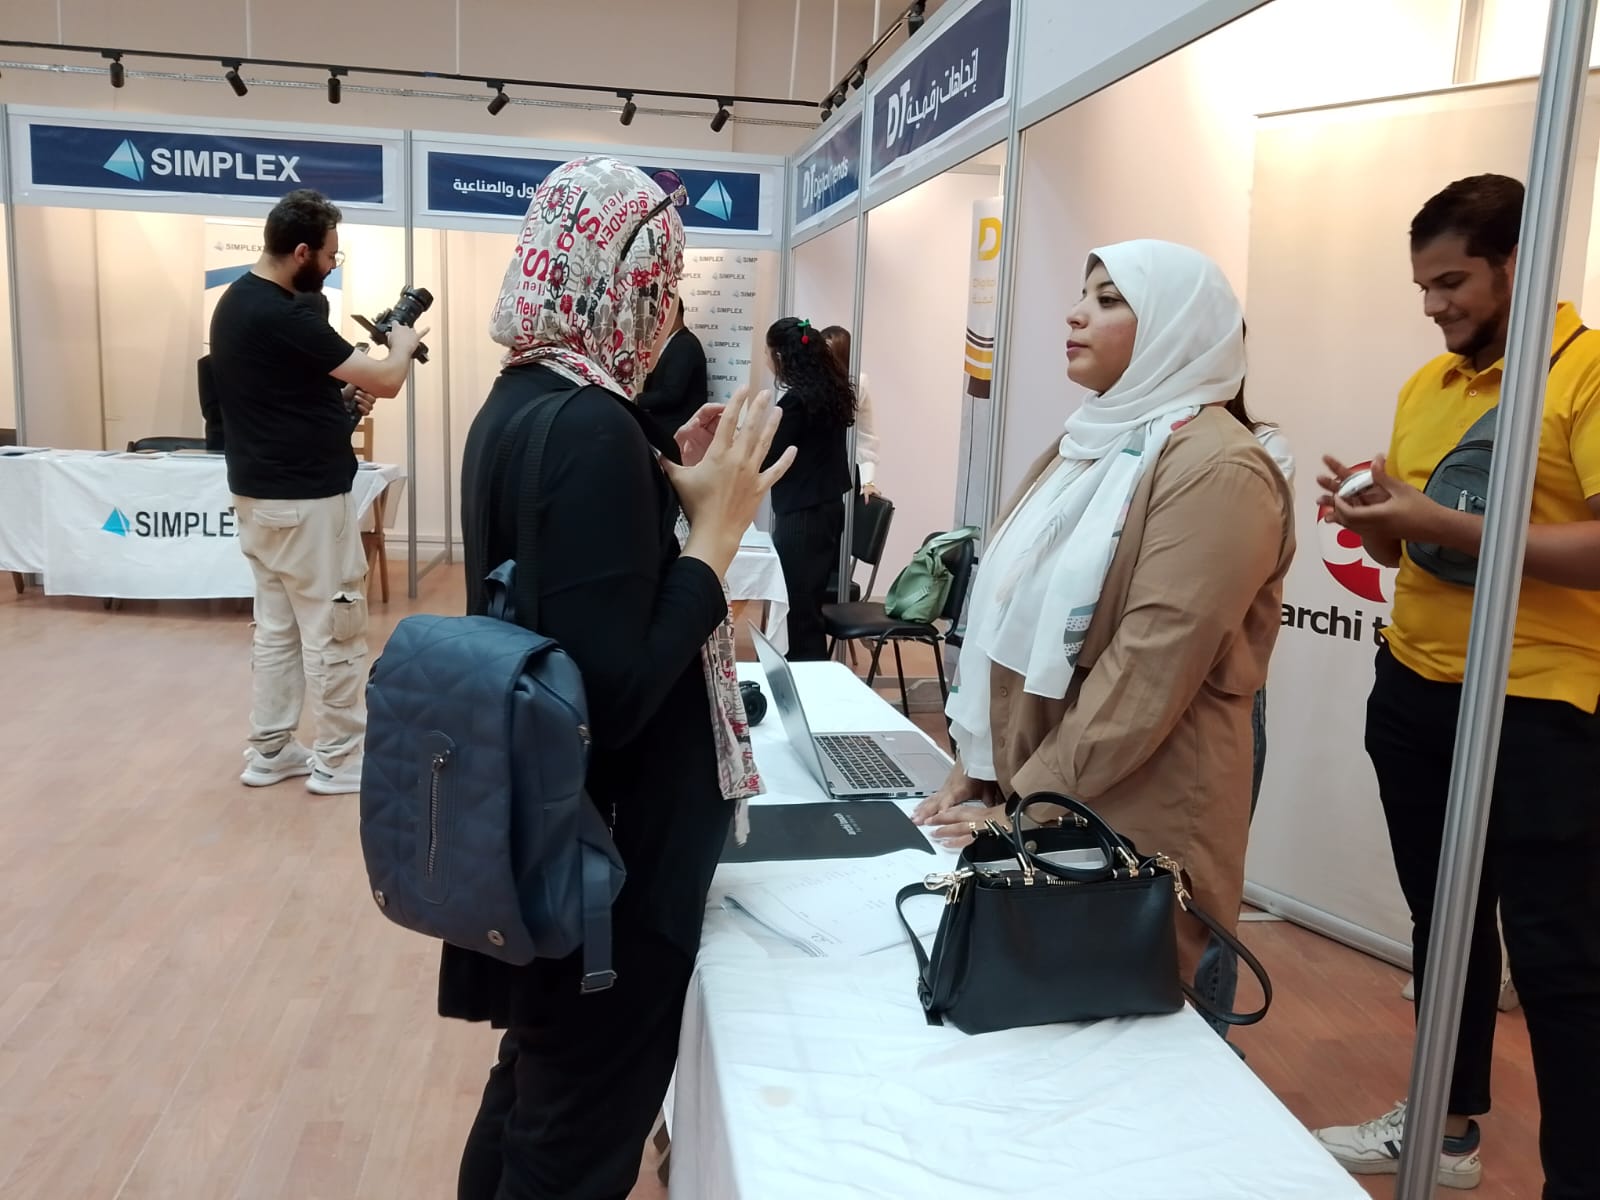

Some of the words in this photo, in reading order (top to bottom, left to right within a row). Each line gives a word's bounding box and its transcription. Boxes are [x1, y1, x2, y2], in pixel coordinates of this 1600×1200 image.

[150, 147, 302, 183] SIMPLEX
[453, 178, 514, 198] والصناعية
[225, 243, 263, 252] SIMPLEX
[134, 510, 241, 538] SIMPLE
[1280, 602, 1363, 642] archi
